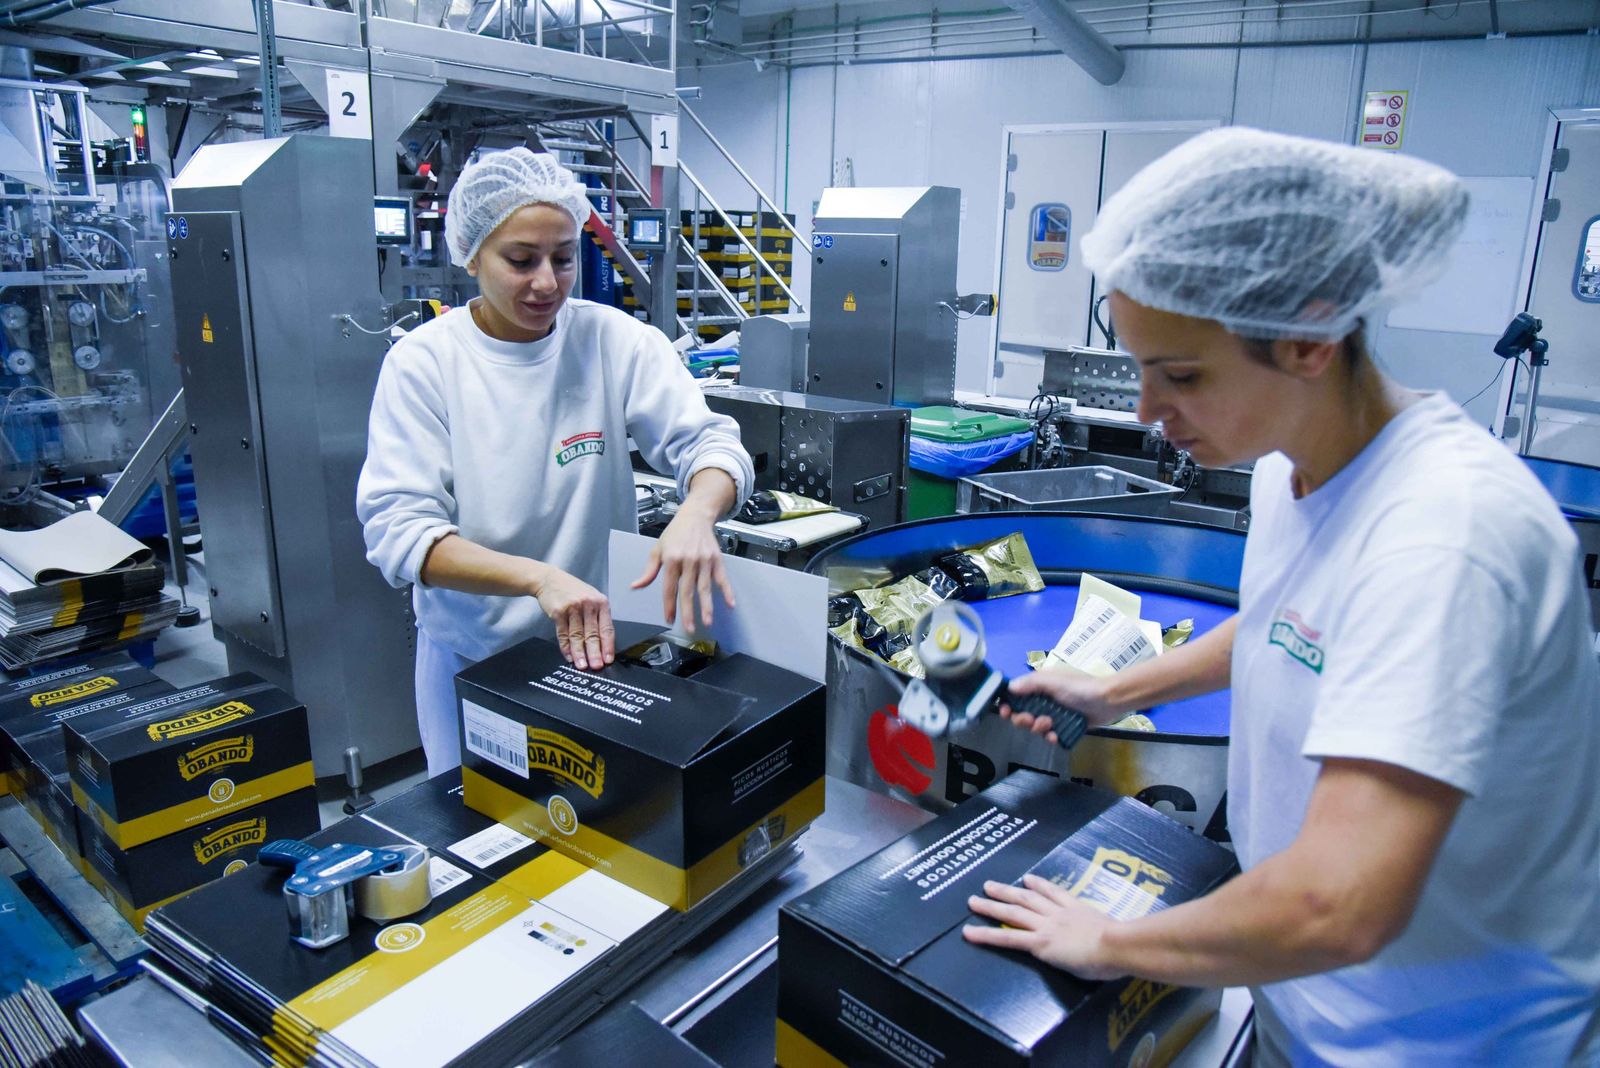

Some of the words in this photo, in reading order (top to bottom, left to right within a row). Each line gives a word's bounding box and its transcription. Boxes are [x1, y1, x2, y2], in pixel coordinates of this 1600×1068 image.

[342, 91, 357, 117] 2
[660, 130, 669, 149] 1
[601, 254, 609, 291] MASTE
[561, 441, 604, 462] OBANDO
[542, 676, 594, 697] SELECCIÓN
[594, 693, 644, 714] GOURMET
[552, 670, 589, 687] PICOS
[591, 681, 654, 706] RÚSTICOS
[157, 703, 237, 733] OBANDO
[187, 747, 247, 775] OBANDO
[528, 744, 596, 788] OBANDO
[734, 769, 755, 787] PICOS
[202, 829, 260, 859] OBANDO
[953, 812, 1009, 849] SELECCIÓN
[984, 817, 1024, 843] PICOS
[903, 845, 957, 881] GOURMET
[917, 842, 985, 888] RÚSTICOS
[841, 998, 874, 1024] PICOS
